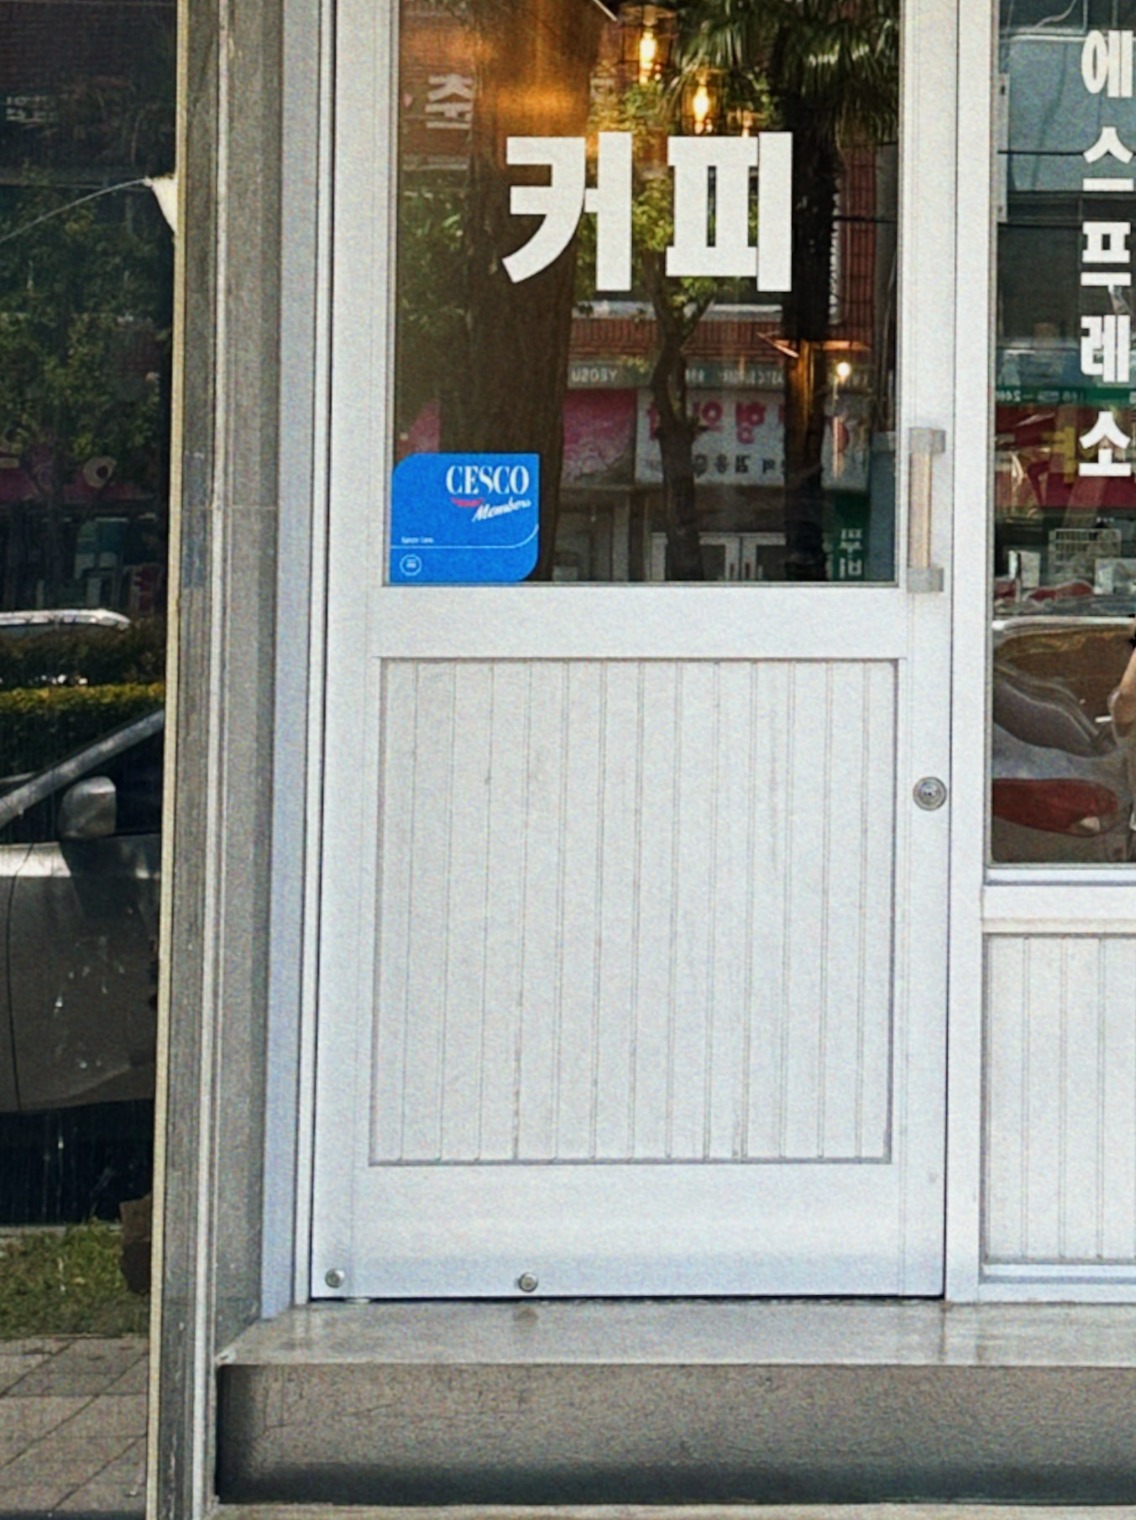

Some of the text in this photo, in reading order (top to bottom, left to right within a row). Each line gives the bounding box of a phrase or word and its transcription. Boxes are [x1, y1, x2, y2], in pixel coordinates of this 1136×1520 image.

[501, 130, 794, 293] 커피
[1079, 29, 1134, 477] 에스프레소
[445, 464, 530, 495] CESCO
